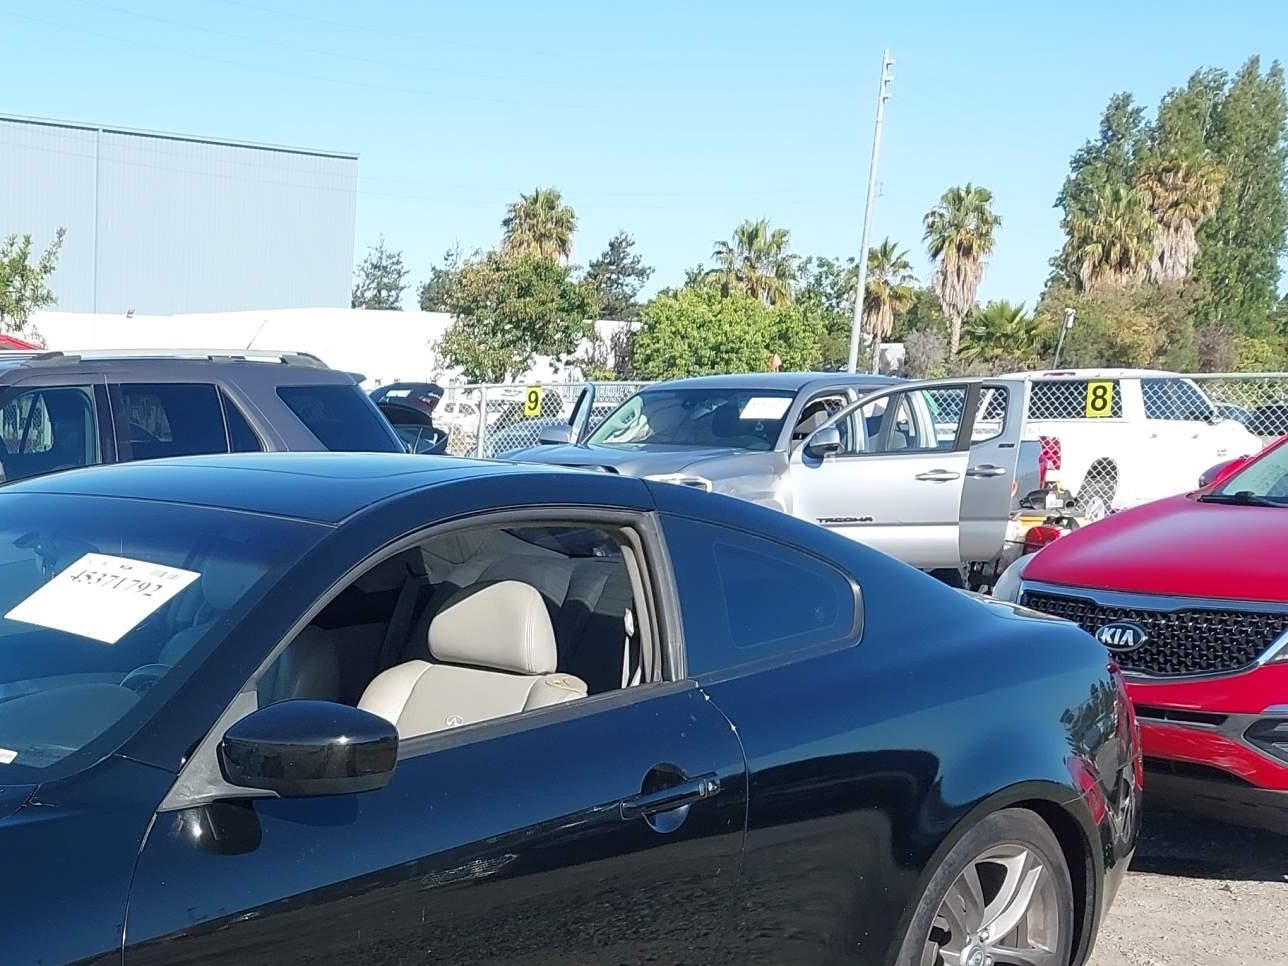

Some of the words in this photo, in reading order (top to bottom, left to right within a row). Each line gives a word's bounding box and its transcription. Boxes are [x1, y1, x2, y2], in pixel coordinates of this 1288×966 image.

[527, 390, 539, 411] 9
[1091, 384, 1108, 411] 8
[1100, 627, 1134, 646] KIA
